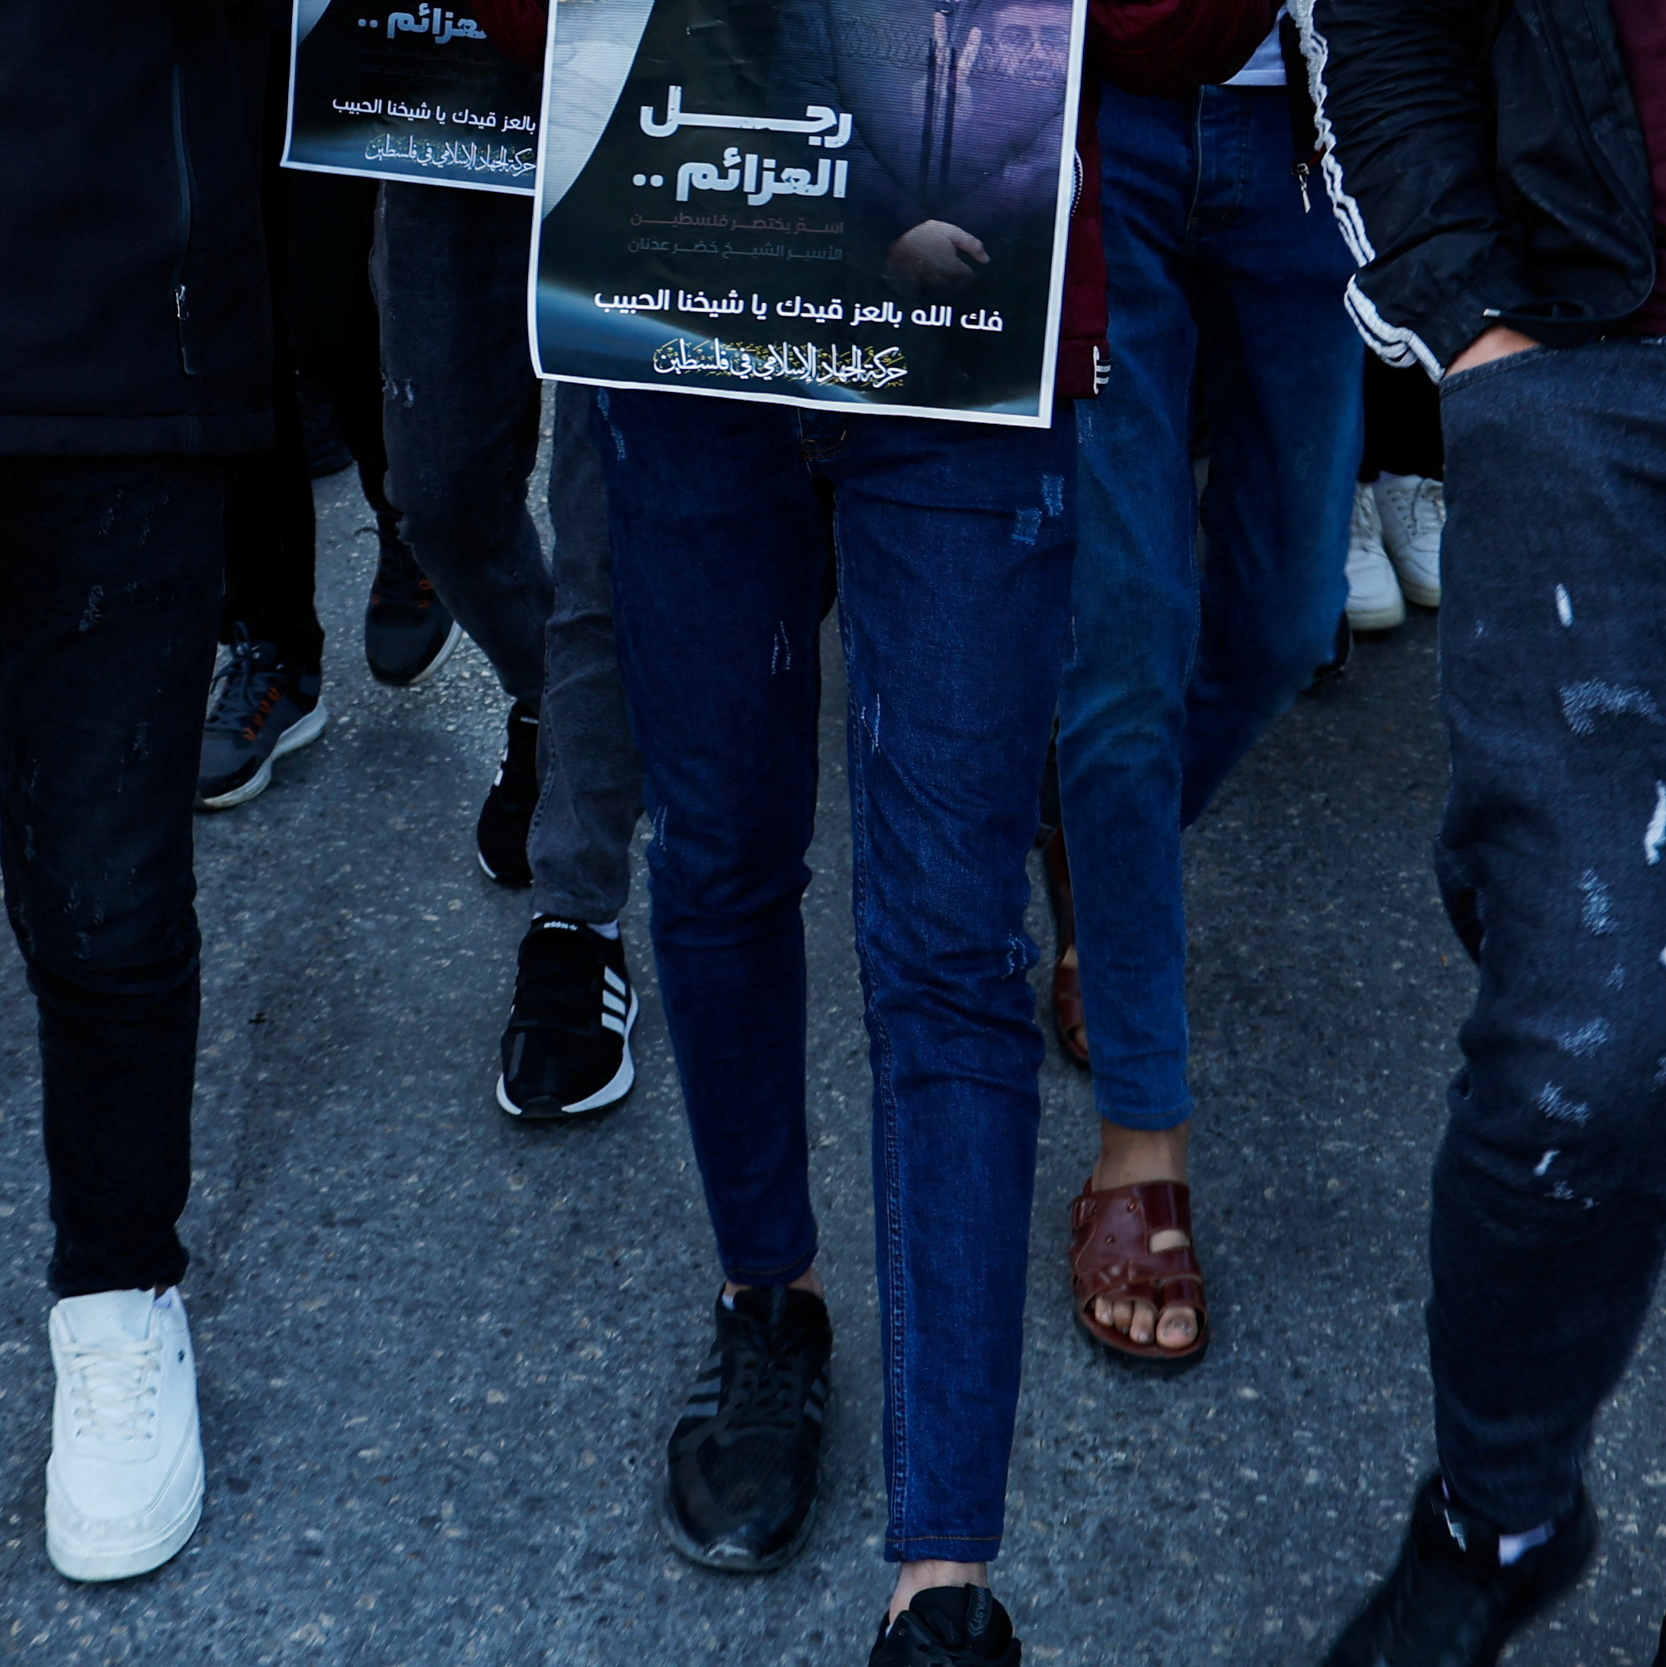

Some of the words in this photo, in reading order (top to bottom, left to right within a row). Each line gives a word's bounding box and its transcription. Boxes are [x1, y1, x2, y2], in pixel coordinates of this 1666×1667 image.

[387, 2, 488, 45] عزائم
[332, 98, 382, 116] الحبيب
[435, 106, 446, 124] يا
[640, 85, 853, 149] رجل
[675, 147, 848, 206] العزائم
[594, 289, 670, 314] الحبيب
[677, 290, 744, 319] شيخنا
[751, 294, 767, 321] يا
[776, 296, 843, 325] قيدك
[851, 301, 903, 328] بالعز
[911, 304, 952, 326] الله
[960, 309, 1004, 332] فك
